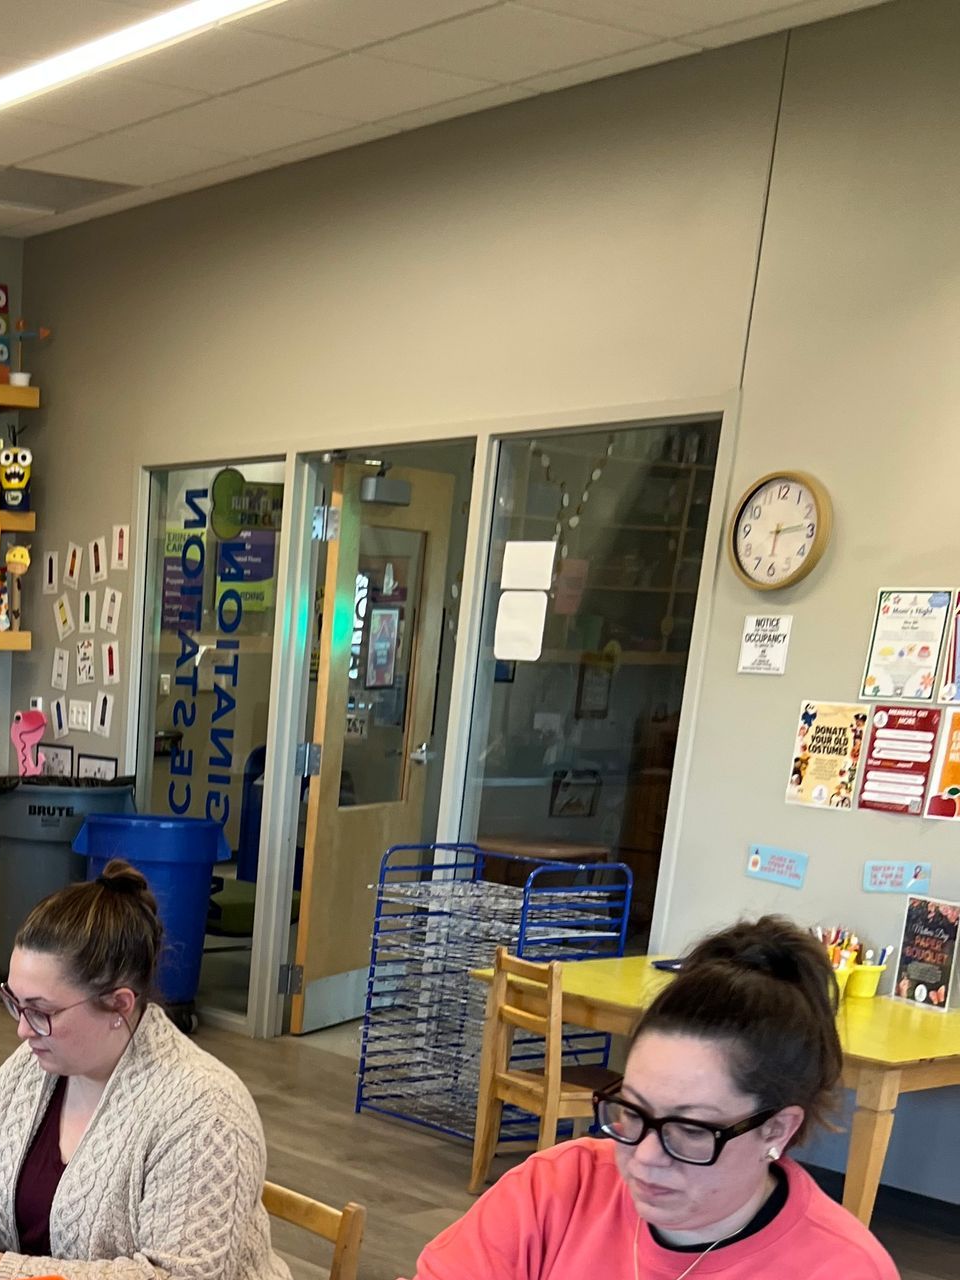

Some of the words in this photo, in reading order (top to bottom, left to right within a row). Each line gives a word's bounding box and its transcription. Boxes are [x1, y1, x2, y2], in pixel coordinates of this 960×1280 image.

[778, 484, 790, 500] 12
[750, 504, 762, 520] 10
[804, 503, 814, 519] 2
[743, 523, 752, 539] 9
[805, 522, 816, 538] 3
[743, 543, 753, 558] 8
[796, 543, 806, 557] 4
[753, 556, 762, 571] 7
[766, 562, 776, 577] 6
[755, 617, 781, 628] NOTICE
[744, 633, 788, 644] OCCUPANCY
[815, 725, 848, 737] DONATE
[811, 735, 833, 745] YOUR
[833, 737, 849, 746] OLD
[808, 744, 848, 756] COSTUMES
[28, 805, 74, 817] BRUTE
